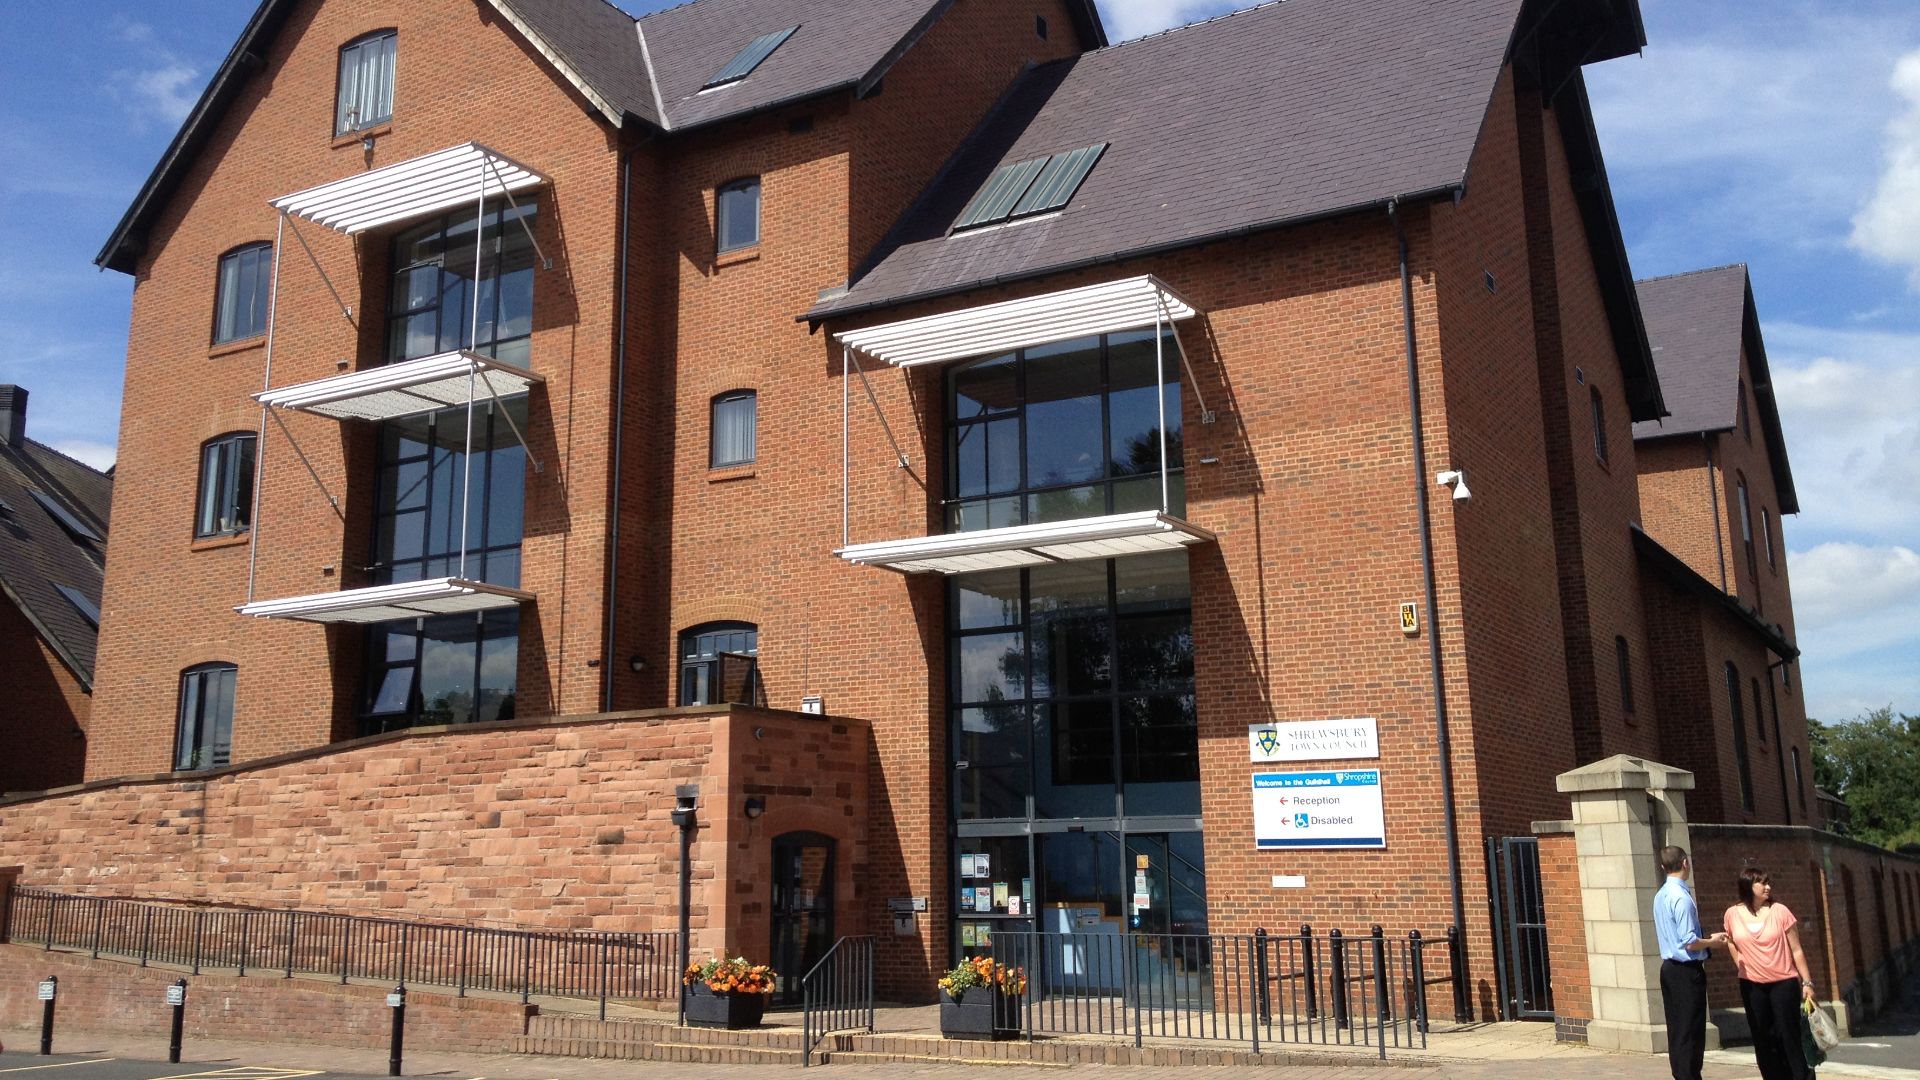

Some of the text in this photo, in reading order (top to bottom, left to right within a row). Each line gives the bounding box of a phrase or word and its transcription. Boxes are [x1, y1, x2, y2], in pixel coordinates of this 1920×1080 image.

[1288, 727, 1368, 740] SHREWSBURY
[1291, 740, 1368, 751] TOWN COUNCIL
[1305, 778, 1331, 786] Guildhall
[1344, 772, 1377, 782] Shropshire
[1293, 796, 1340, 807] Reception
[1310, 816, 1353, 825] Disabled
